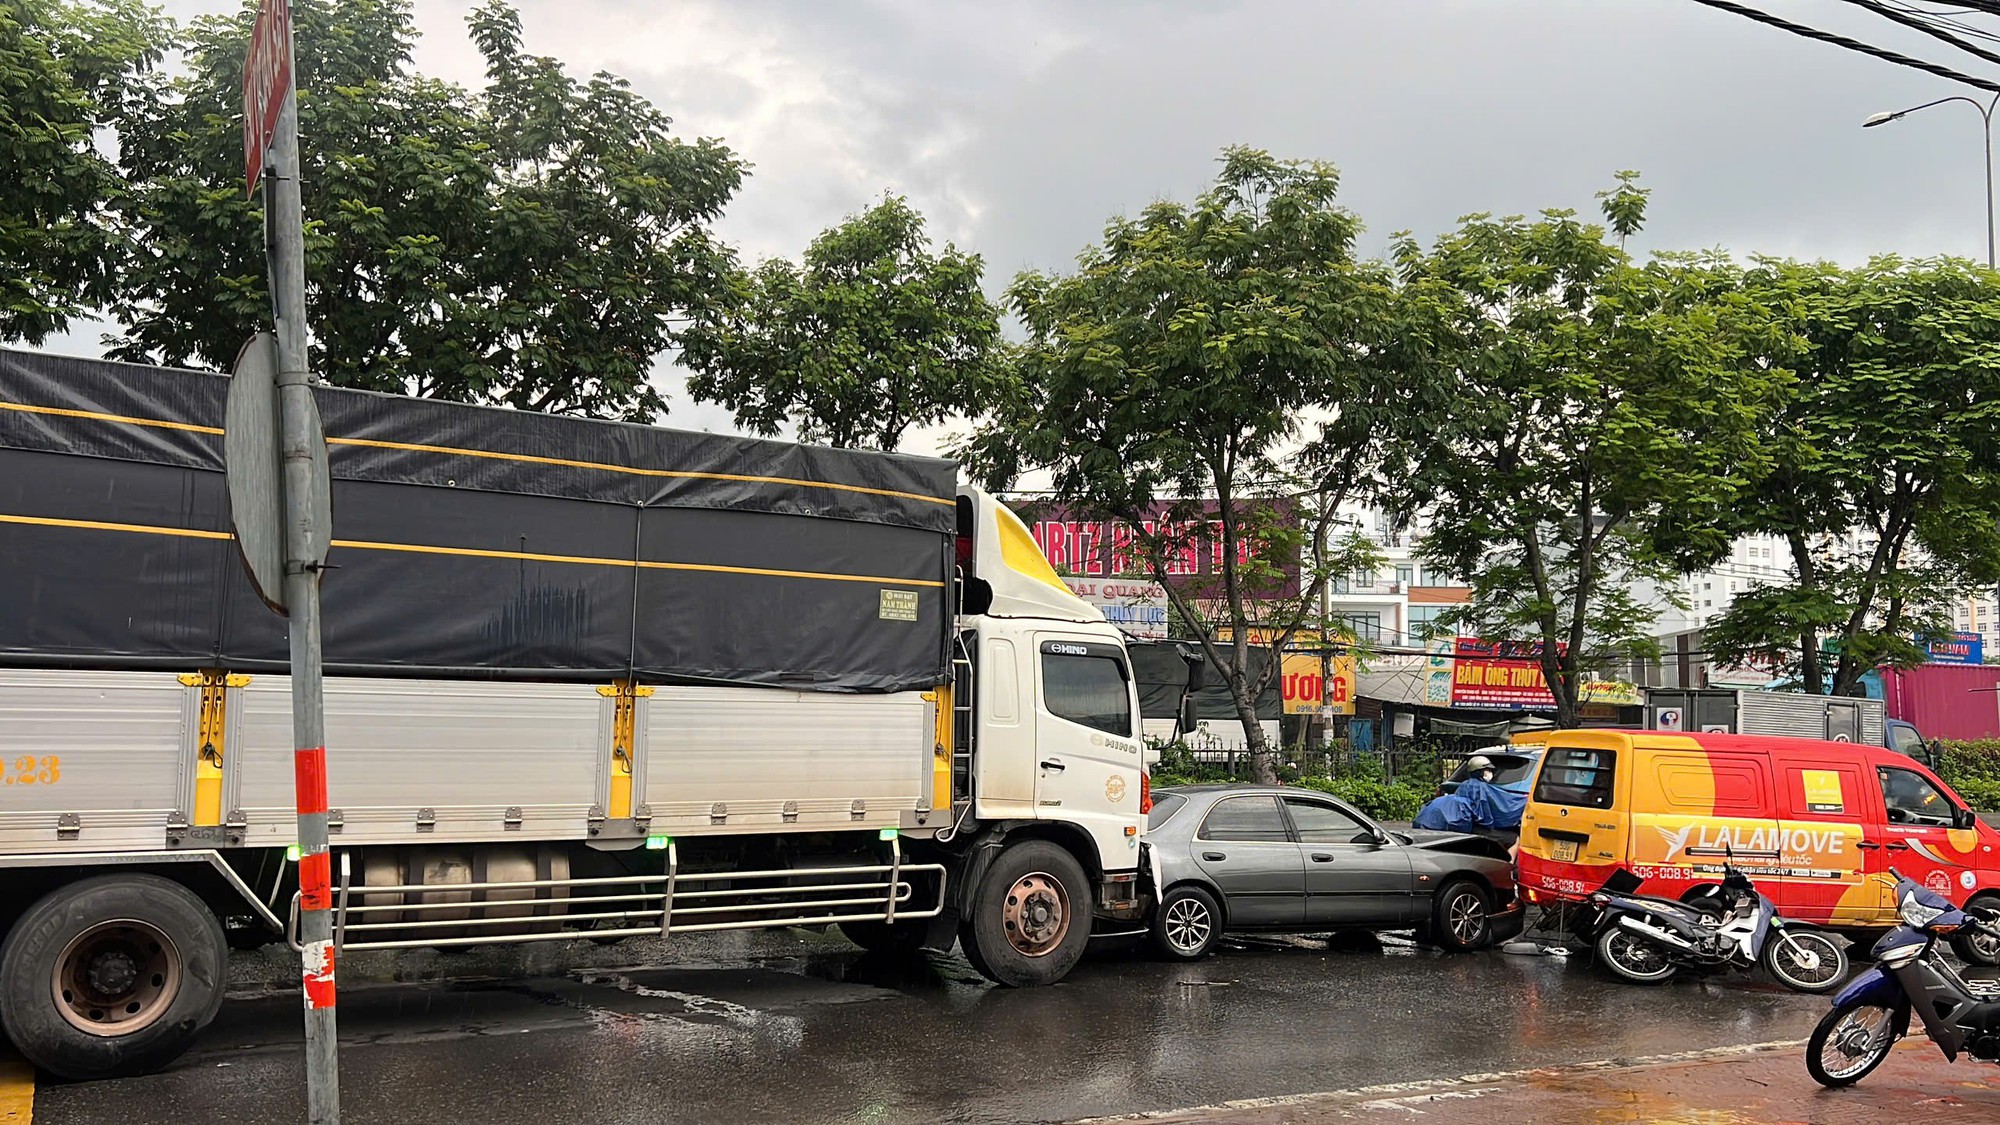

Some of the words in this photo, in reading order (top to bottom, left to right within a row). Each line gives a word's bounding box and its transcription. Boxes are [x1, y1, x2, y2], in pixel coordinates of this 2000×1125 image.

[1103, 583, 1164, 599] QUANG
[1062, 644, 1088, 656] HINO
[1105, 738, 1137, 755] HINO
[1698, 825, 1845, 854] LALAMOVE
